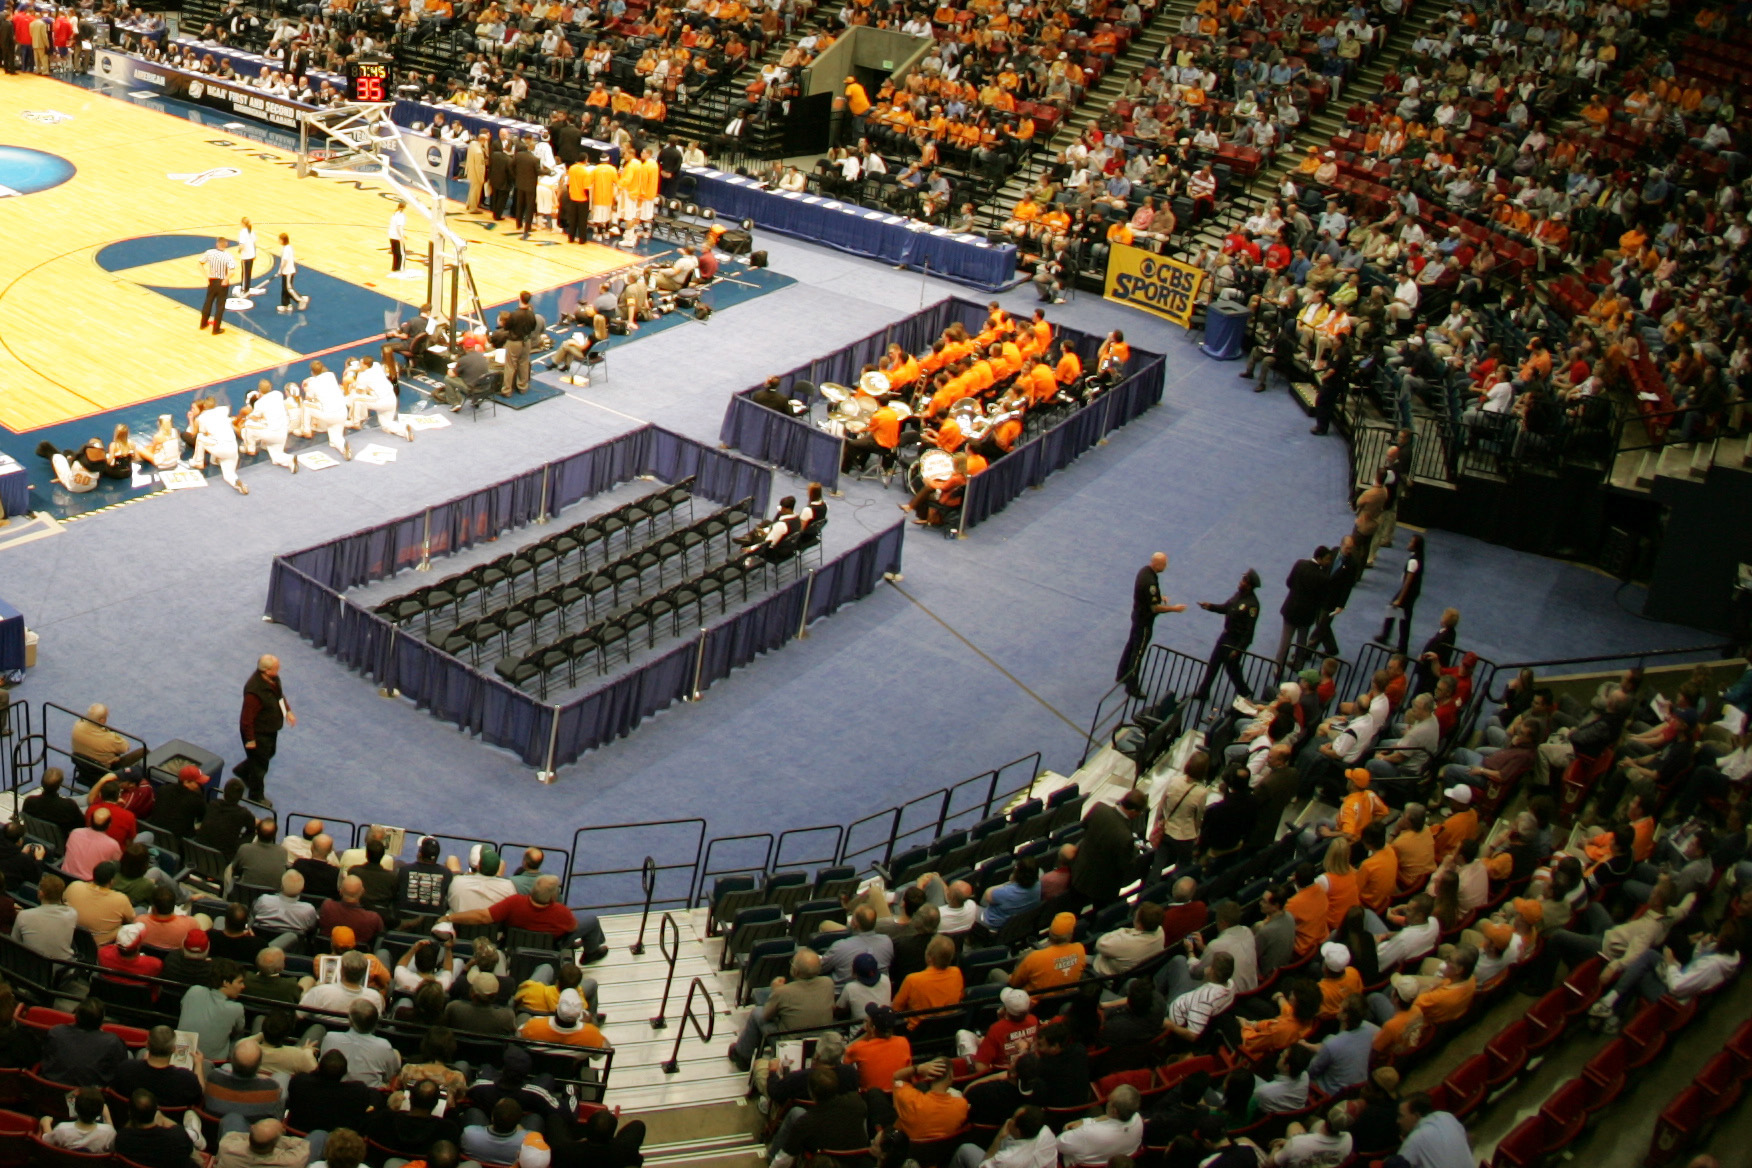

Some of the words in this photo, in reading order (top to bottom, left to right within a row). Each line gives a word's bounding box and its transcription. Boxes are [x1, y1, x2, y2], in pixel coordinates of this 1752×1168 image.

[133, 68, 166, 87] AMERICAN
[358, 65, 387, 79] 7:45
[356, 77, 384, 101] 35
[228, 90, 249, 105] FIRST
[249, 97, 265, 111] AND
[265, 101, 295, 118] SECOND
[1157, 263, 1196, 293] CBS
[1111, 272, 1190, 313] SPORTS
